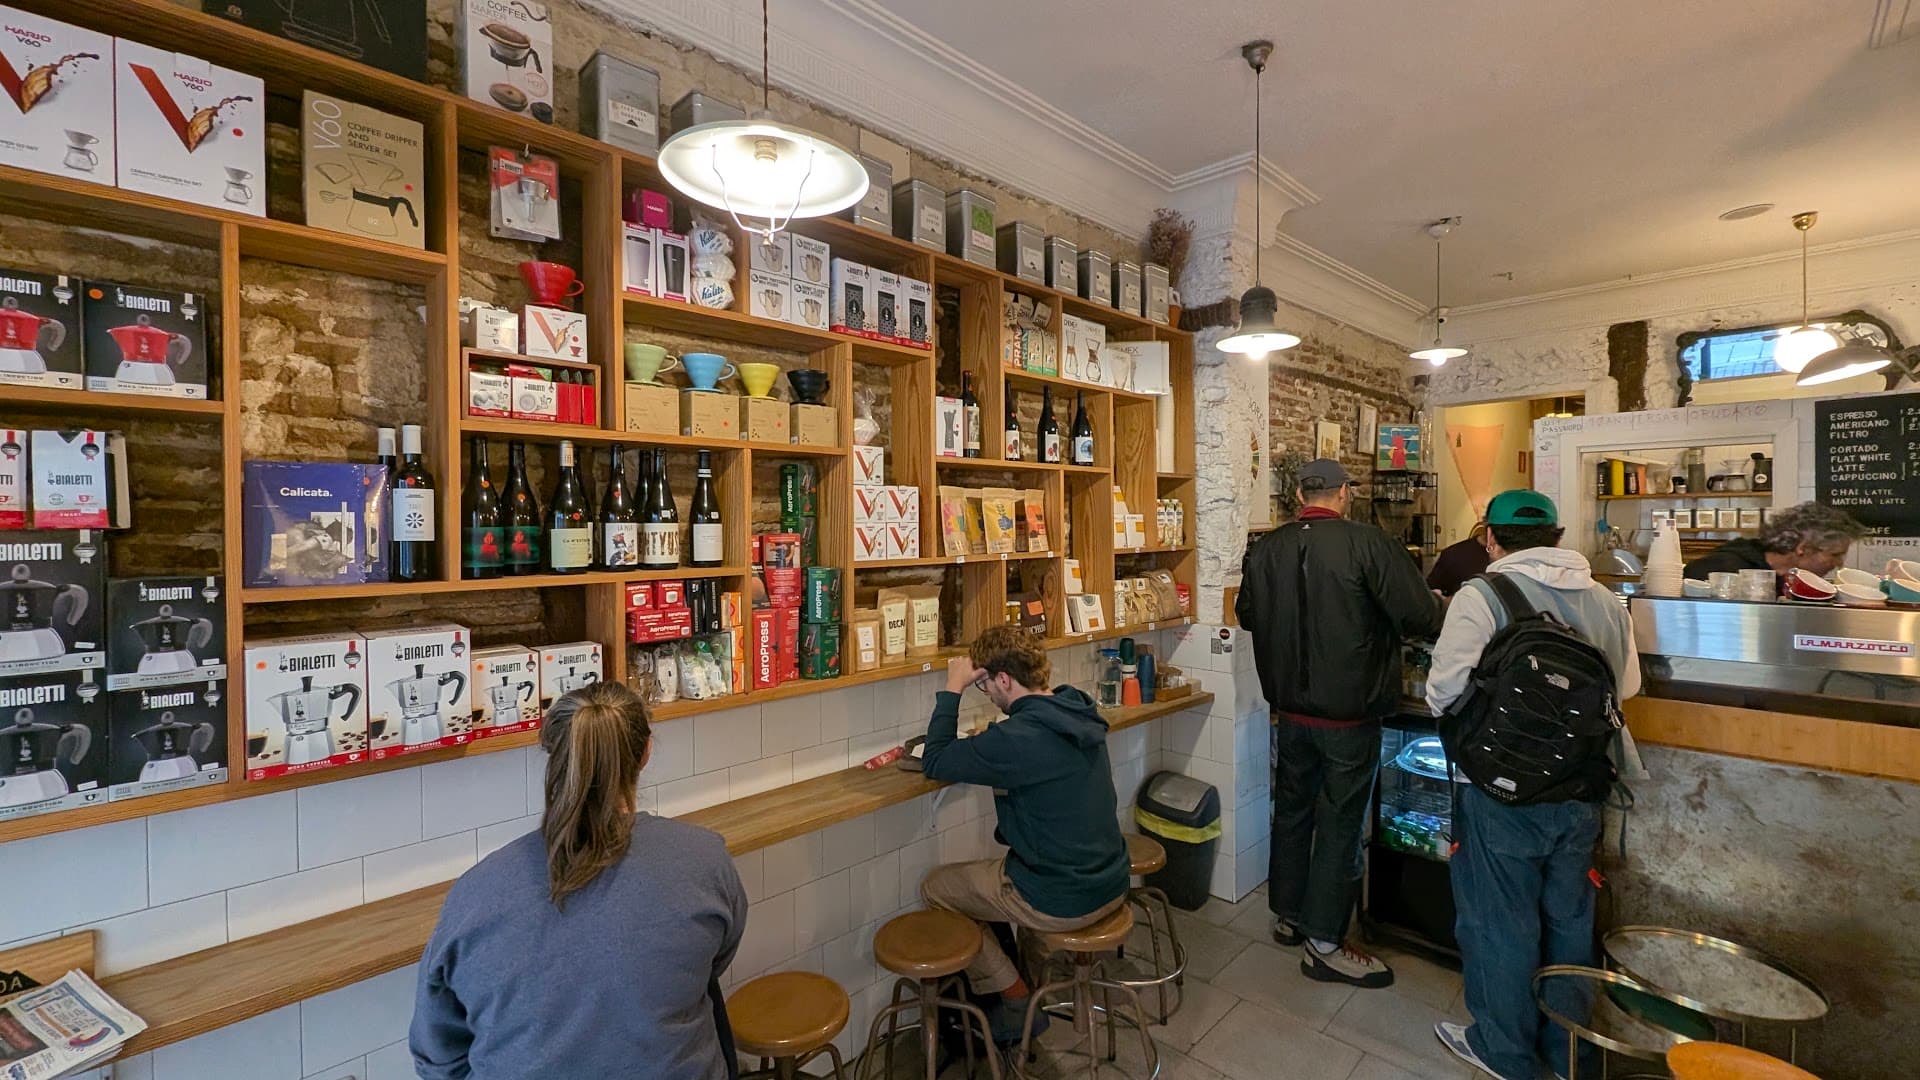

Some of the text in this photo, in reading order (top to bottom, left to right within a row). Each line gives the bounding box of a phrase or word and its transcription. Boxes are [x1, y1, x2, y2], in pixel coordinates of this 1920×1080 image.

[487, 0, 527, 21] COFFEE
[4, 25, 51, 43] HARIO
[15, 35, 41, 48] V60
[173, 71, 213, 87] HARIO
[182, 80, 204, 92] V60
[312, 100, 342, 148] V60
[347, 121, 418, 147] COFFEE DRIPPER
[347, 131, 369, 142] AND
[347, 138, 397, 158] SERVER SET
[0, 276, 41, 296] IALETTI
[126, 294, 171, 313] BIALETTI
[1830, 410, 1878, 420] ESPRESSO
[1830, 419, 1889, 430] AMERICANO
[1830, 430, 1869, 440] FILTRO
[1830, 444, 1879, 454] CORTADO
[1830, 455, 1855, 463] FLAT
[1860, 453, 1891, 462] WHITE
[1831, 464, 1865, 473] LATTE
[55, 474, 93, 486] BIALETTI
[1831, 472, 1897, 482] CAPPUCCINO
[279, 487, 333, 498] Calicata.
[1831, 488, 1859, 496] CHAI
[149, 586, 192, 601] BIALETTI
[649, 625, 680, 633] AeroPress
[888, 618, 906, 630] DECA
[404, 644, 444, 661] BIALETTI
[760, 620, 769, 682] AeroPress
[289, 654, 336, 672] BIALETTI
[563, 653, 587, 664] BIALETTI
[495, 662, 521, 673] BIALETTI
[150, 692, 194, 709] BIALETTI
